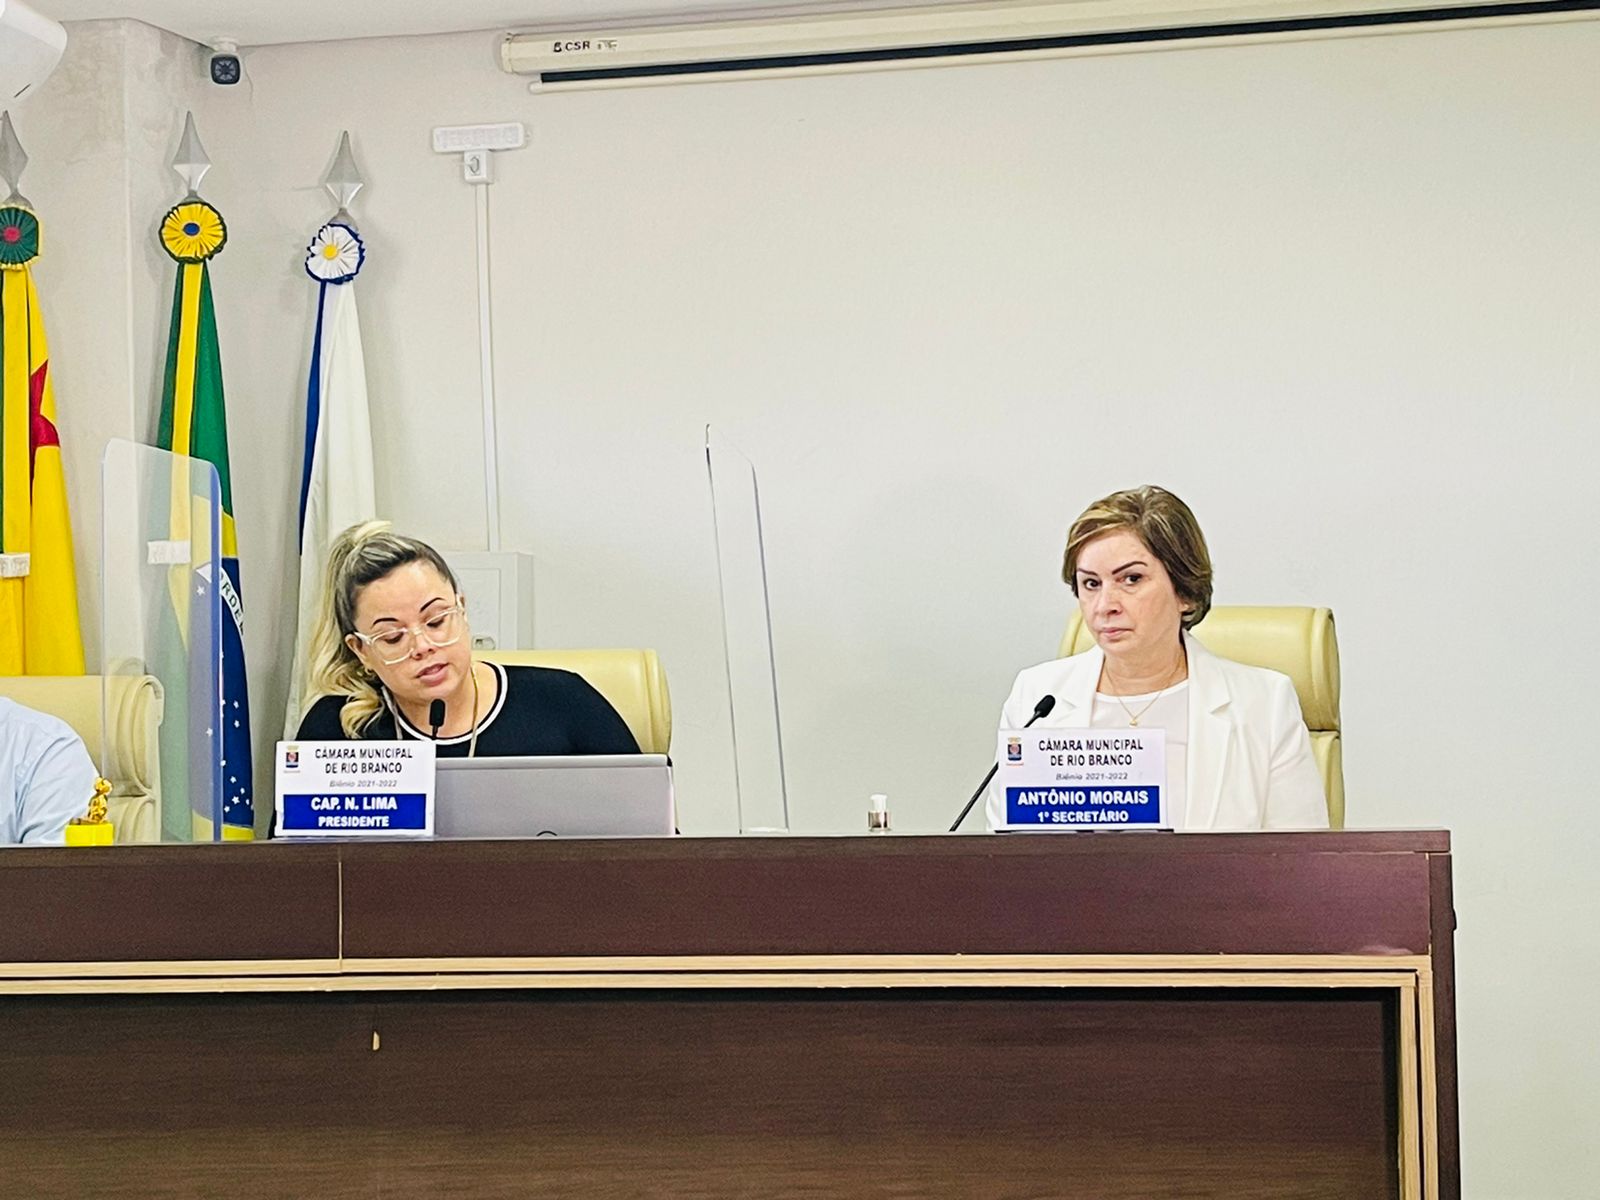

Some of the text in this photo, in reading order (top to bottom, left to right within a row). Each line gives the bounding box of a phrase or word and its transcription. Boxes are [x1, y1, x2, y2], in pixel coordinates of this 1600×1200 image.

[565, 40, 590, 51] CSR
[220, 572, 244, 636] RDE
[1038, 738, 1144, 751] CÂMARA MUNICIPAL
[315, 747, 413, 759] CÂMARA MUNICIPAL
[1050, 754, 1133, 766] DE RIO BRANCO
[325, 762, 402, 774] DE RIO BRANCO
[1085, 772, 1128, 780] 2021-2022
[357, 779, 397, 788] 2021-2022
[1017, 788, 1149, 806] ANTÔNIO MORAIS
[311, 796, 398, 811] CAP. N. LIMA
[318, 815, 390, 828] PRESIDENTE
[1051, 808, 1129, 823] SECRETÁRIO
